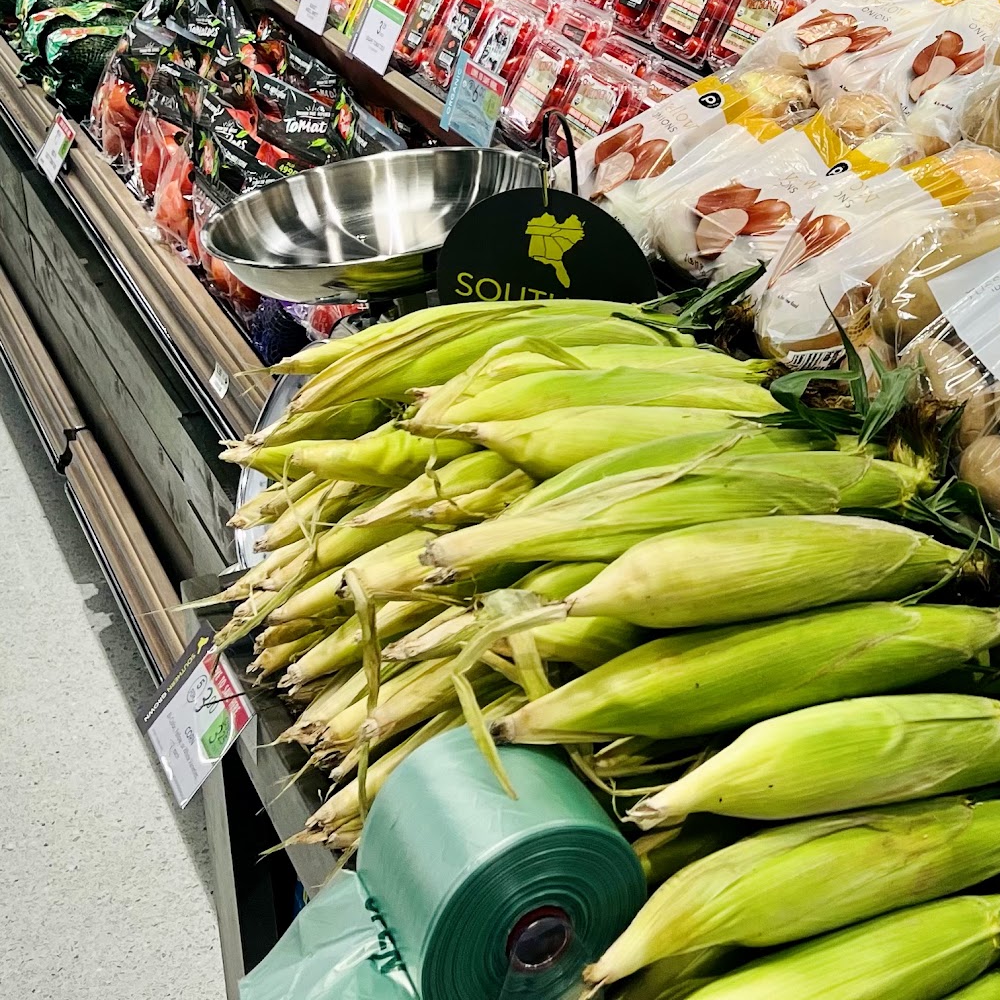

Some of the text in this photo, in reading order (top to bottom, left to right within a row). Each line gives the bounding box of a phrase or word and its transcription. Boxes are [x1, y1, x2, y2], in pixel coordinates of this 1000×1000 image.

[446, 67, 463, 115] ORGANIC
[166, 653, 196, 693] SOUTHERN
[143, 691, 168, 723] GROWN
